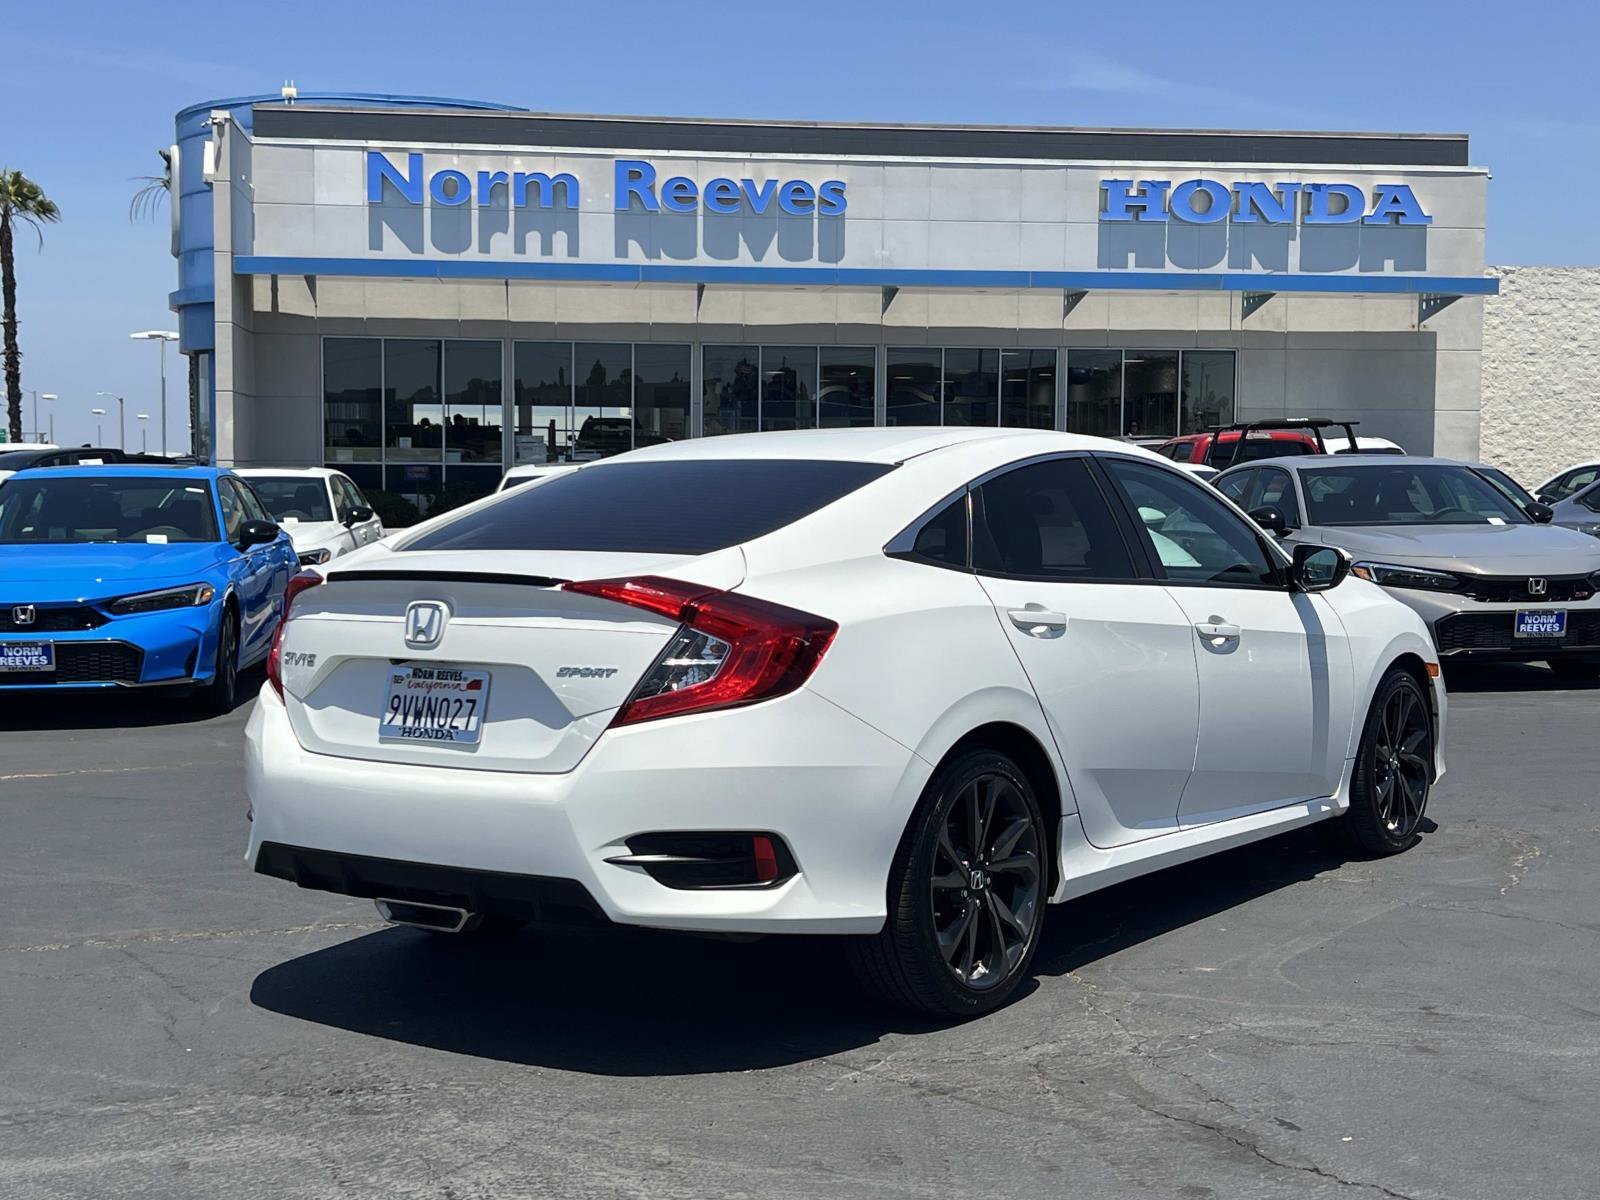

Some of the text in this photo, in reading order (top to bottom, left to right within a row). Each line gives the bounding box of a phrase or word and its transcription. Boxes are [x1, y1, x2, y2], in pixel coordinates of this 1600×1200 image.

[366, 151, 848, 216] Norm Reeves
[1099, 178, 1433, 225] HONDA
[1524, 615, 1557, 624] NORM
[1519, 623, 1560, 632] REEVES
[4, 647, 42, 656] NORM
[0, 656, 48, 666] REEVES
[412, 668, 463, 682] NORM REEVES
[556, 666, 618, 678] SPORT
[387, 694, 477, 730] 9VWN027
[401, 727, 455, 741] HONDA
